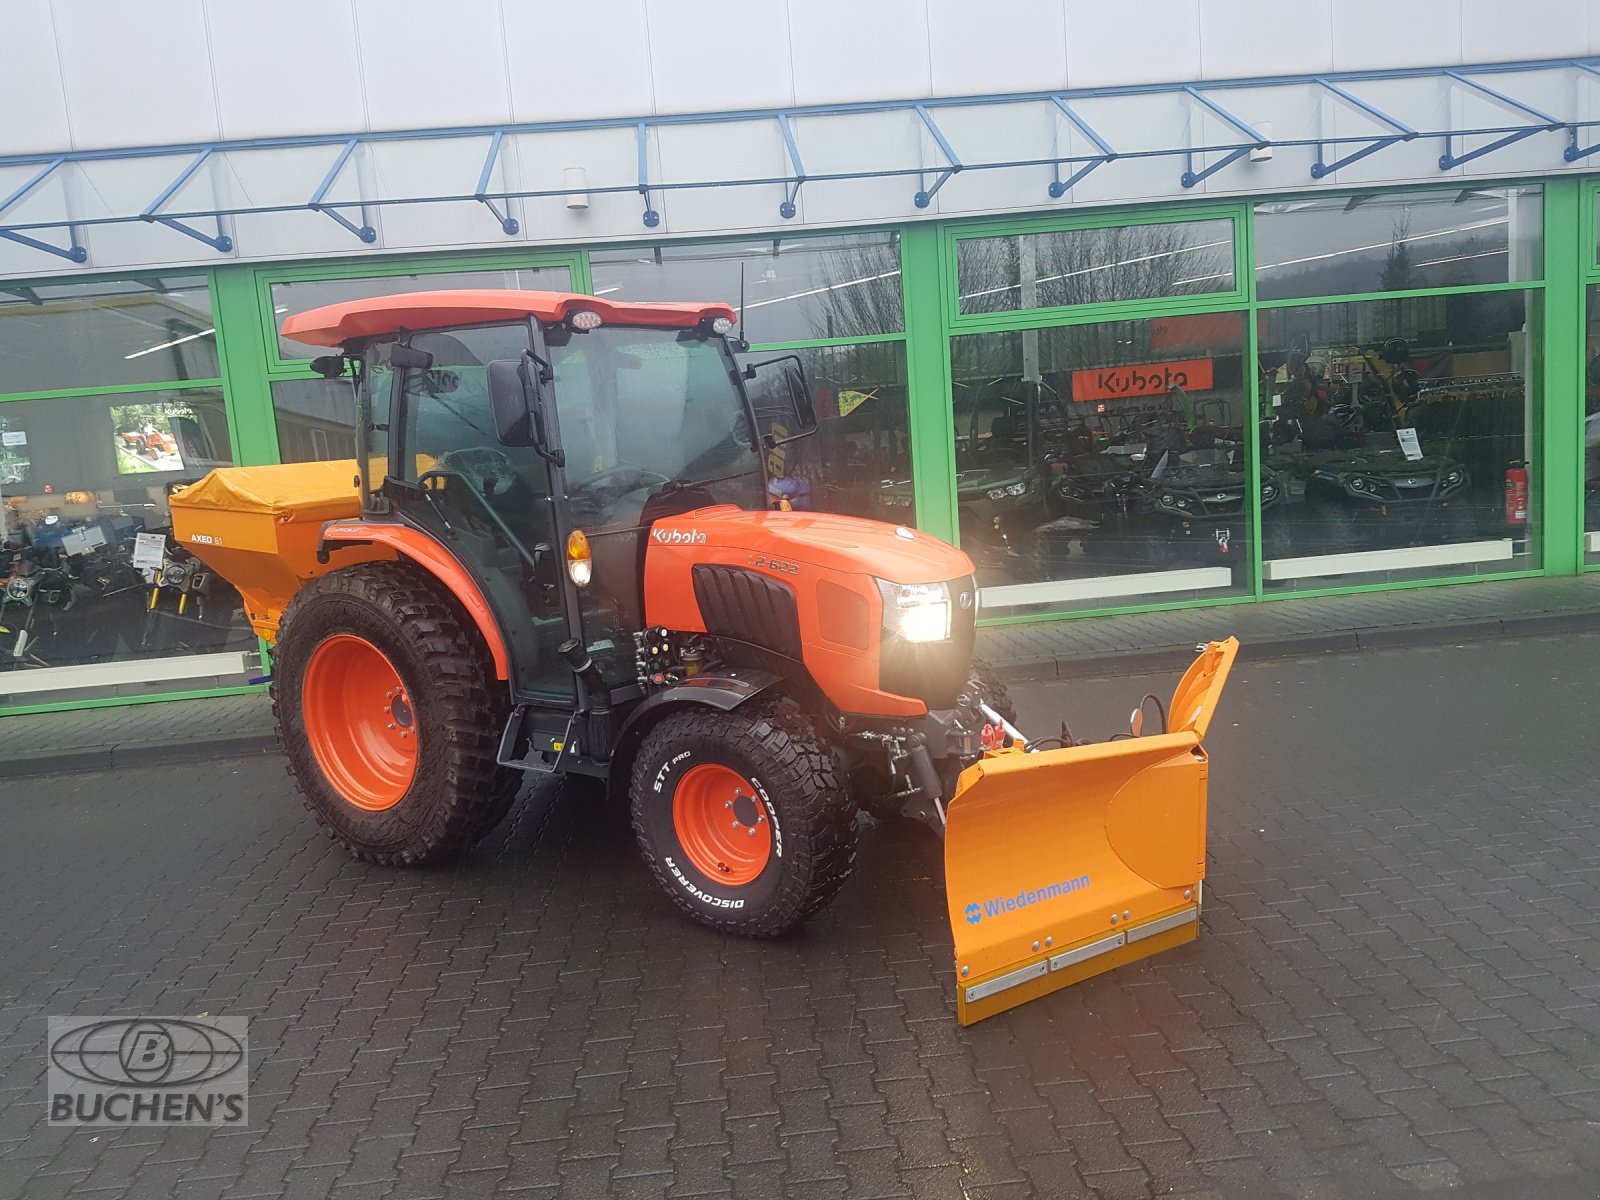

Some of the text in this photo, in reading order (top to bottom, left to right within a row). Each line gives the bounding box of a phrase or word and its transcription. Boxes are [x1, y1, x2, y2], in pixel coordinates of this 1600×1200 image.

[1098, 367, 1188, 393] Kubota
[191, 534, 213, 544] AXEO
[652, 528, 707, 544] Kubota
[653, 751, 691, 793] STT PRO
[751, 776, 783, 858] COOPER
[665, 856, 745, 909] DISCOVERER
[982, 874, 1091, 918] Wiedenmann
